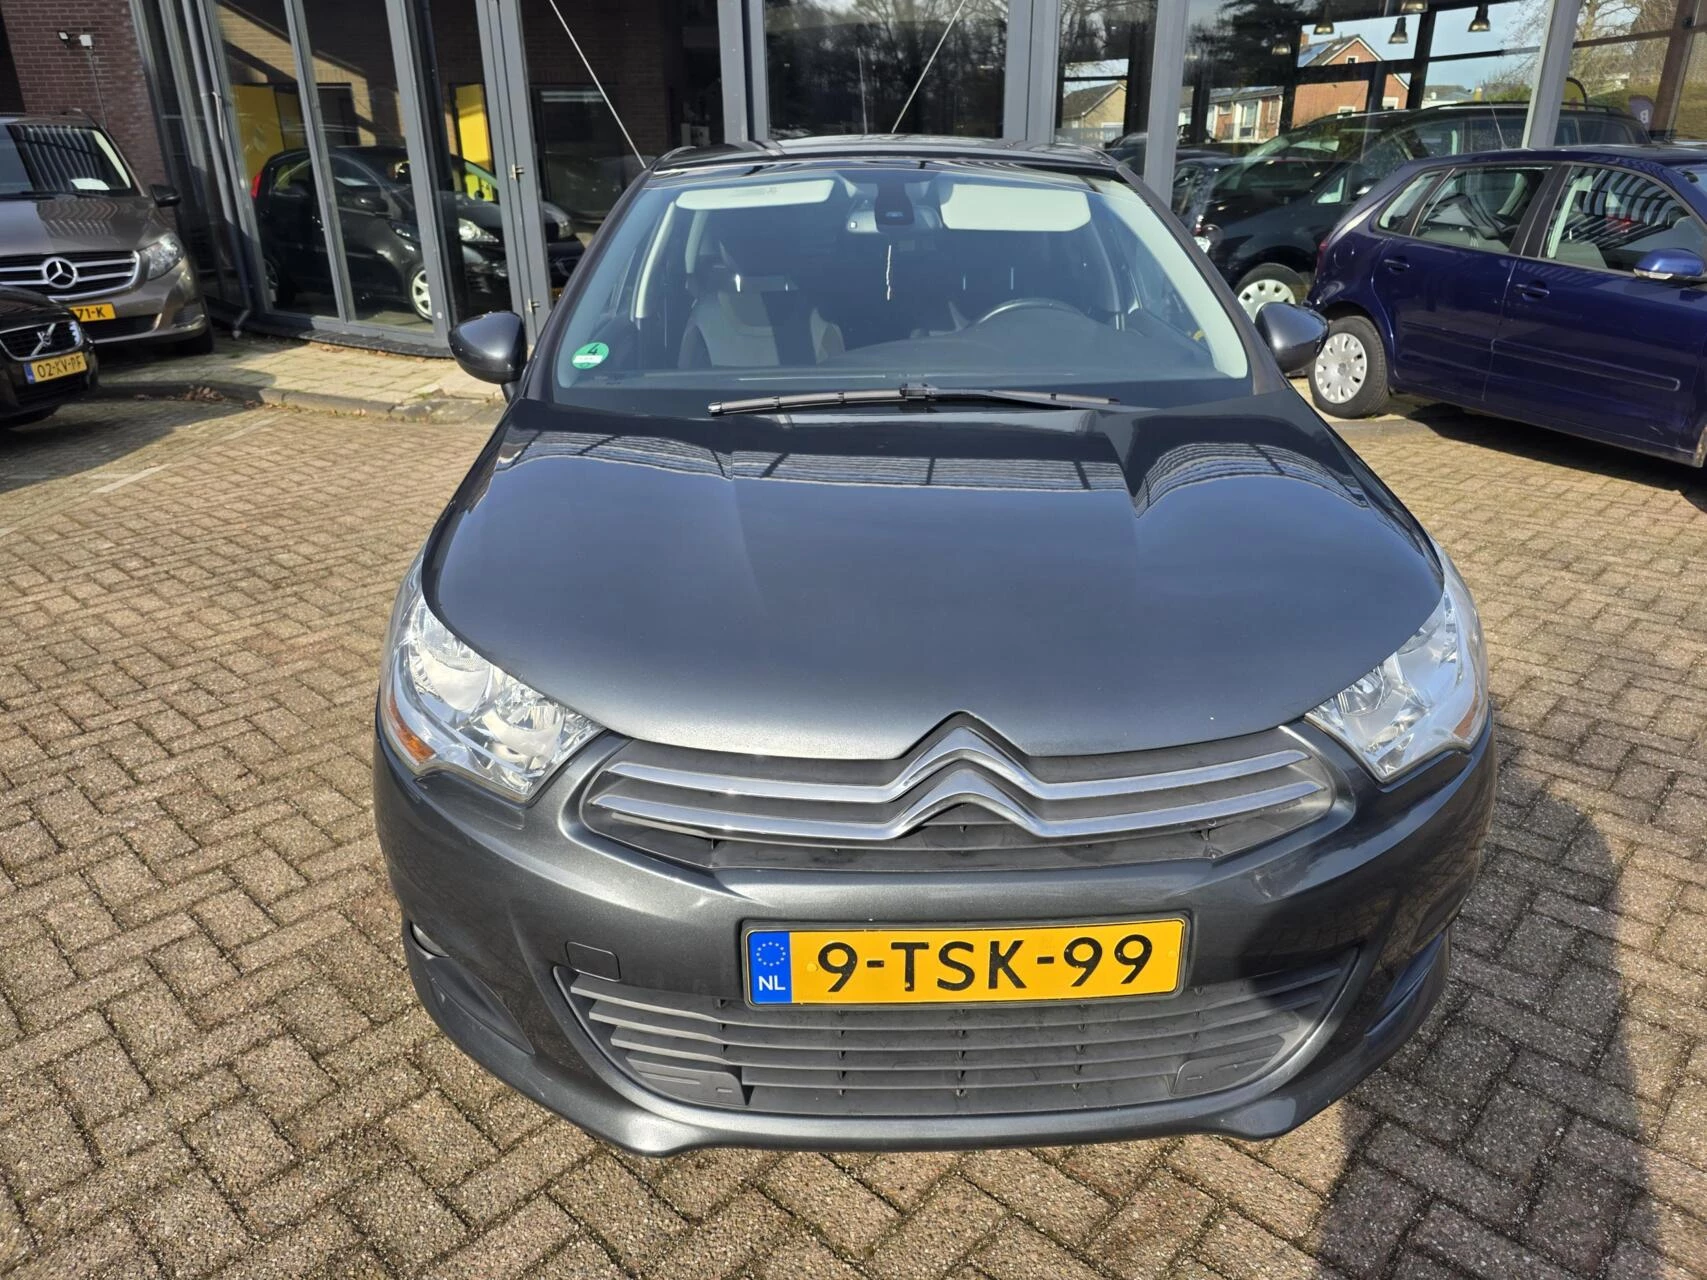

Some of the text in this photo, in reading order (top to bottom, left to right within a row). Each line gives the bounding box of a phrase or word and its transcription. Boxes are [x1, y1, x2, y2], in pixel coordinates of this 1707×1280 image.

[587, 343, 600, 355] 4
[817, 933, 1153, 993] 9-TSK-99
[758, 975, 786, 991] NL
